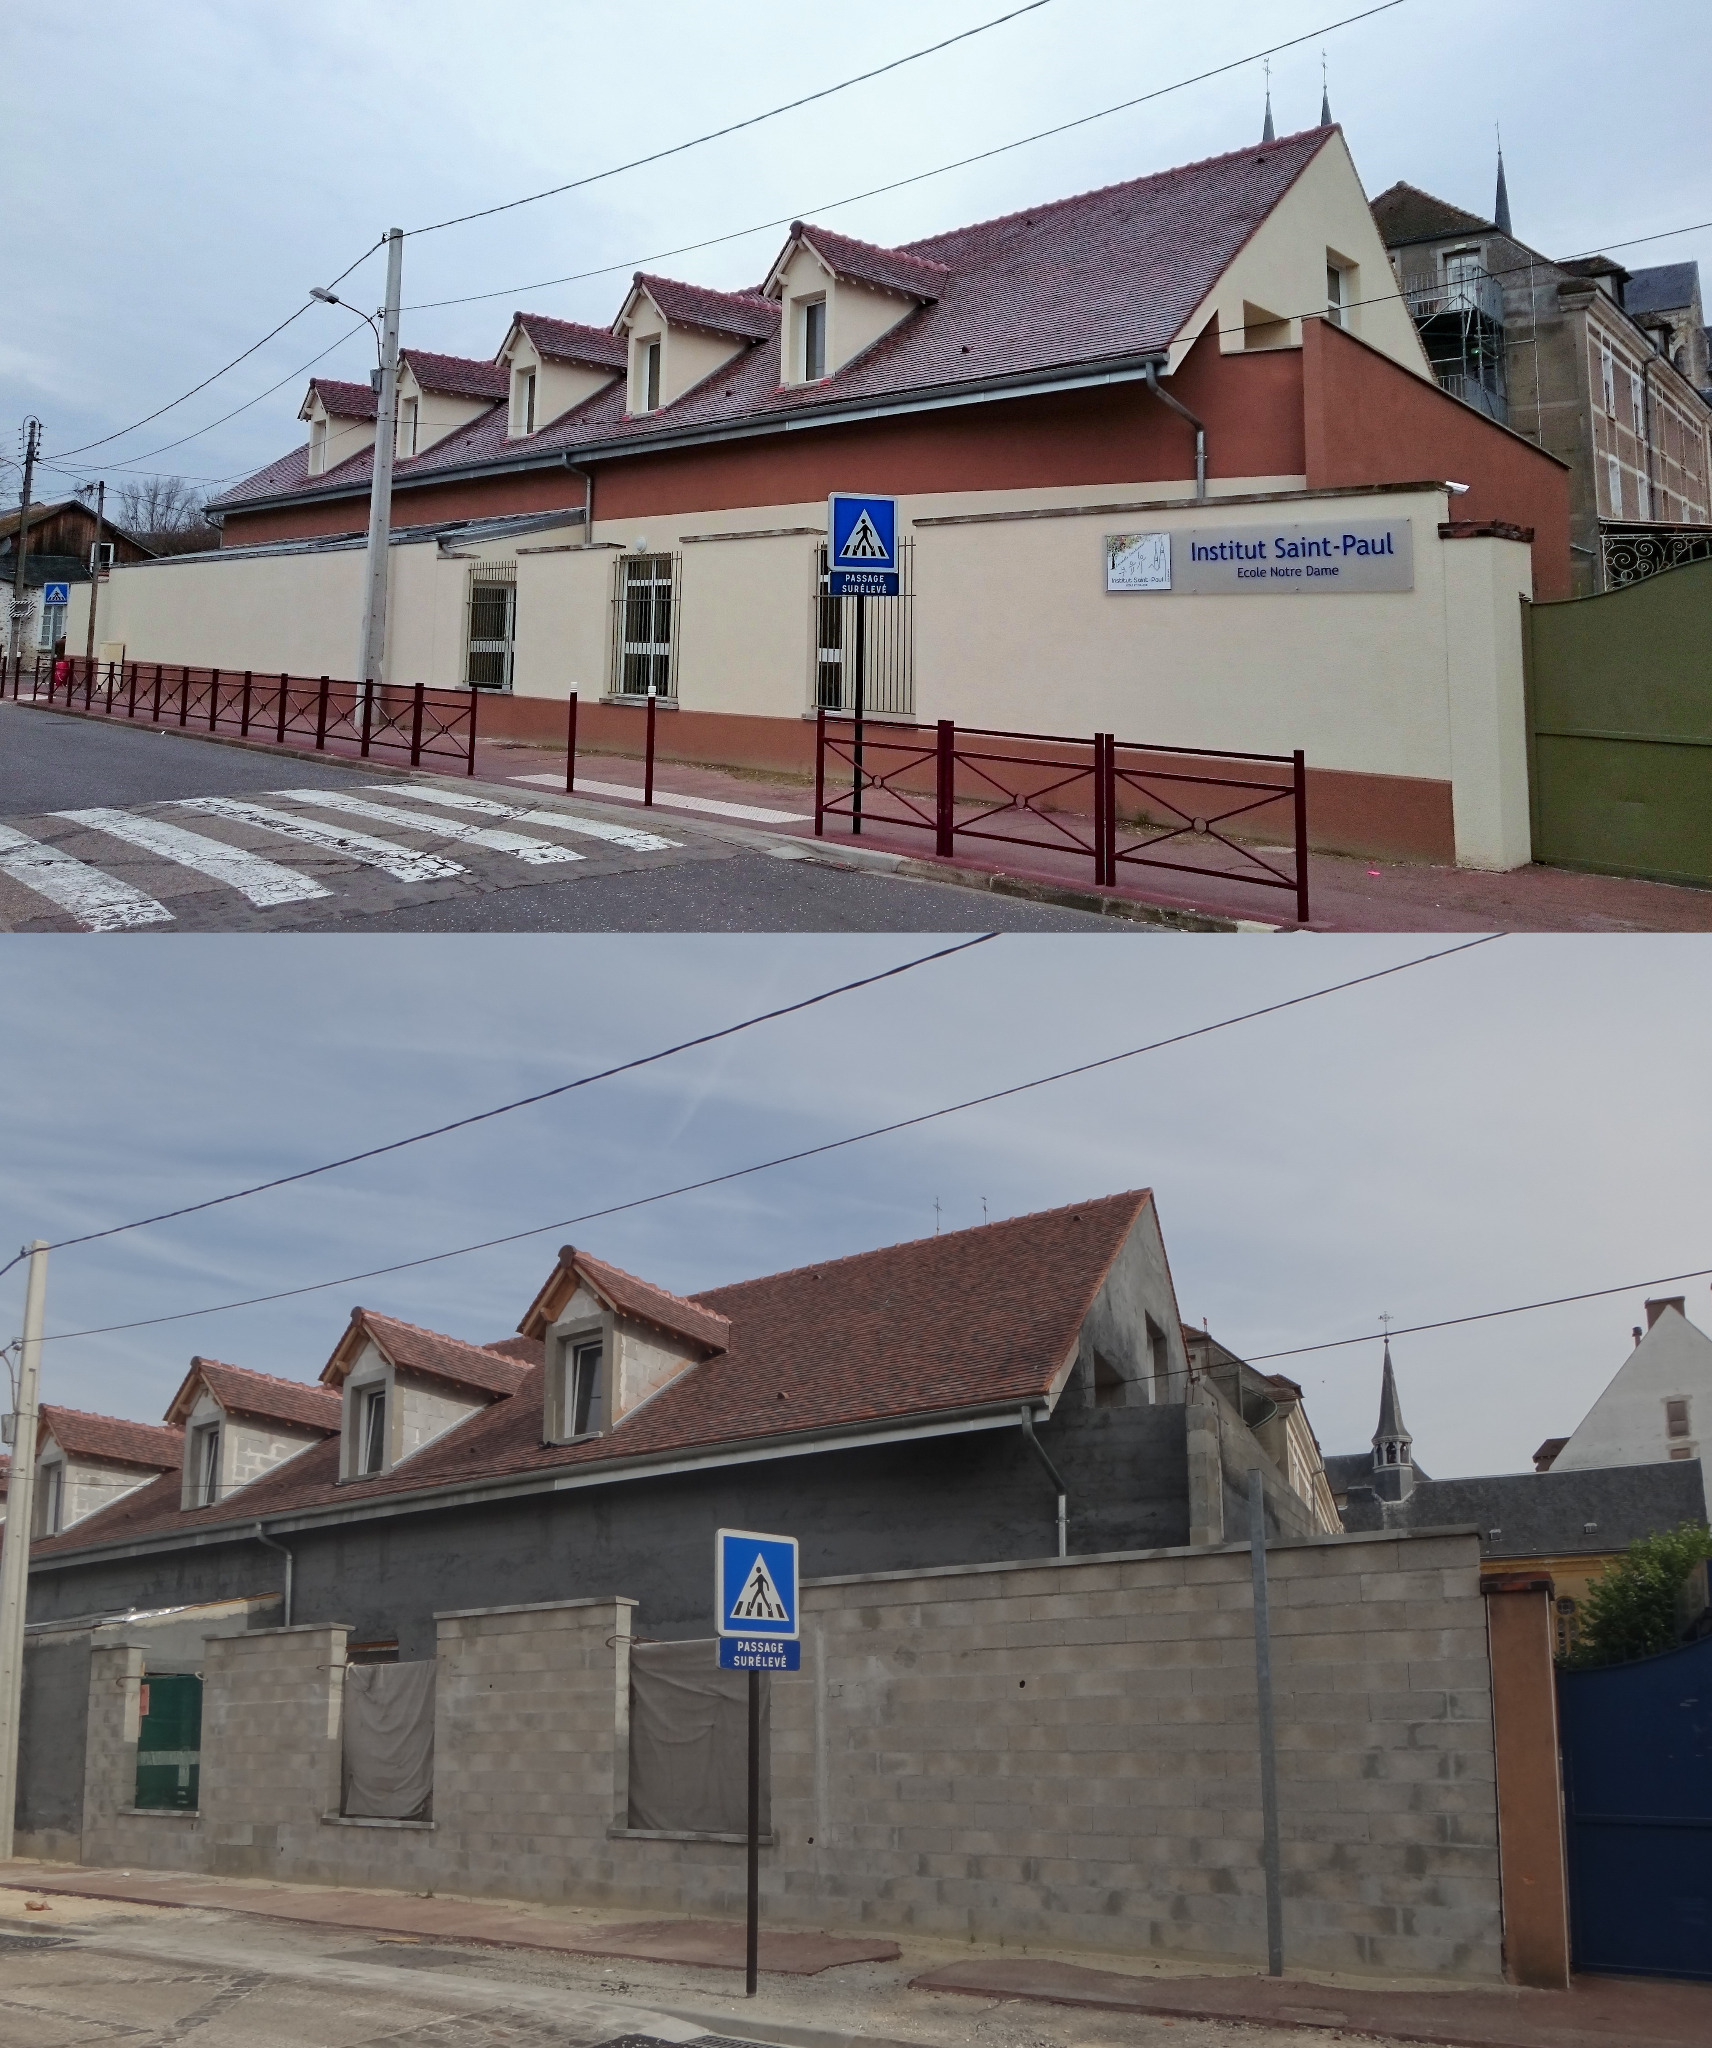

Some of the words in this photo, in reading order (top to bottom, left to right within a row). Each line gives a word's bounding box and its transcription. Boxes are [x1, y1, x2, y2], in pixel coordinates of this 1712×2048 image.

[1191, 540, 1267, 561] Institut
[1274, 532, 1394, 559] Saint-Paul
[1237, 567, 1267, 578] Ecole
[1270, 565, 1302, 577] Notre
[1306, 565, 1339, 576] Dame
[845, 574, 885, 583] PASSAGE
[841, 583, 887, 594] SURÉLEVÉ
[737, 1641, 784, 1653] PASSAGE
[733, 1654, 787, 1668] SURÉLEVÉ
